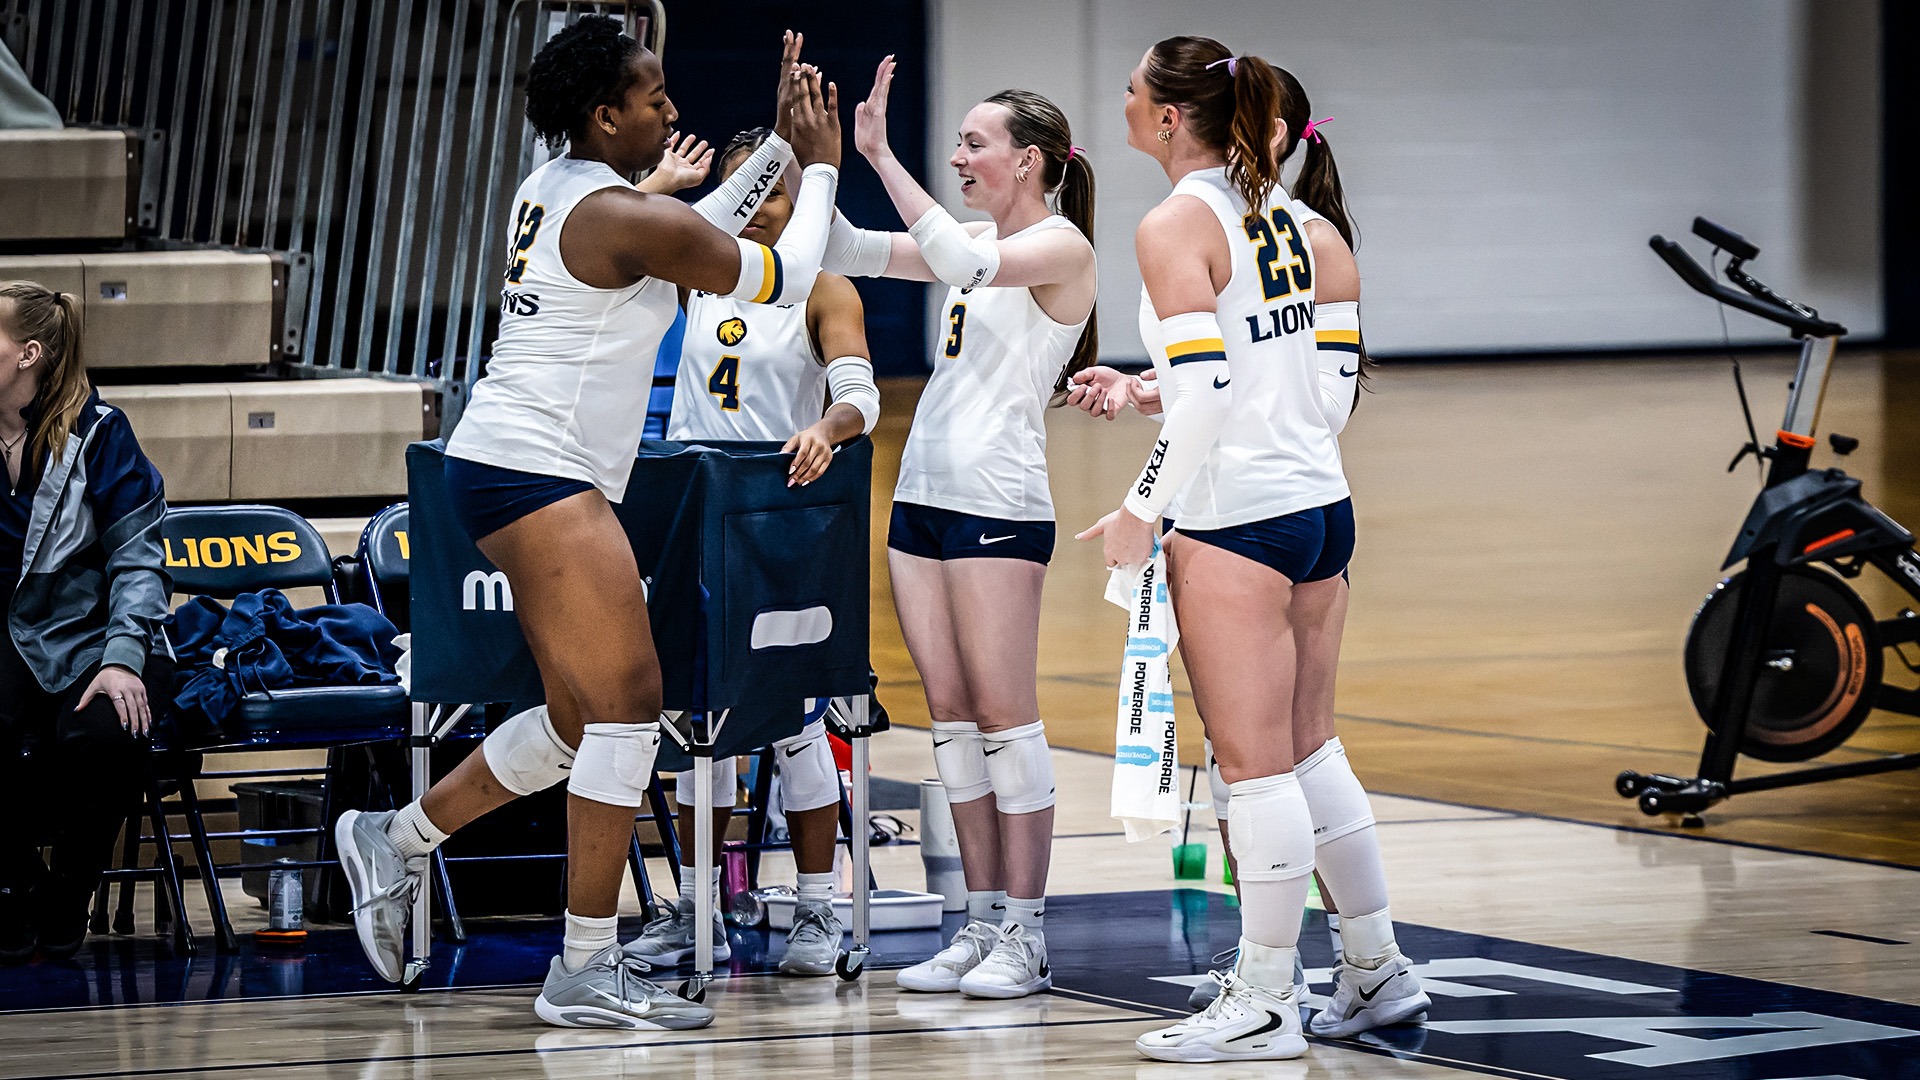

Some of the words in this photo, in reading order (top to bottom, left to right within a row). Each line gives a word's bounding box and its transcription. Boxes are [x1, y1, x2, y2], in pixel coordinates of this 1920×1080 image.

[733, 159, 781, 219] TEXAS
[505, 199, 546, 285] 12
[1242, 205, 1312, 303] 23
[944, 302, 967, 359] 3
[1245, 300, 1316, 343] LION
[707, 354, 741, 412] 4
[1137, 439, 1170, 499] TEXAS
[163, 531, 302, 568] LIONS
